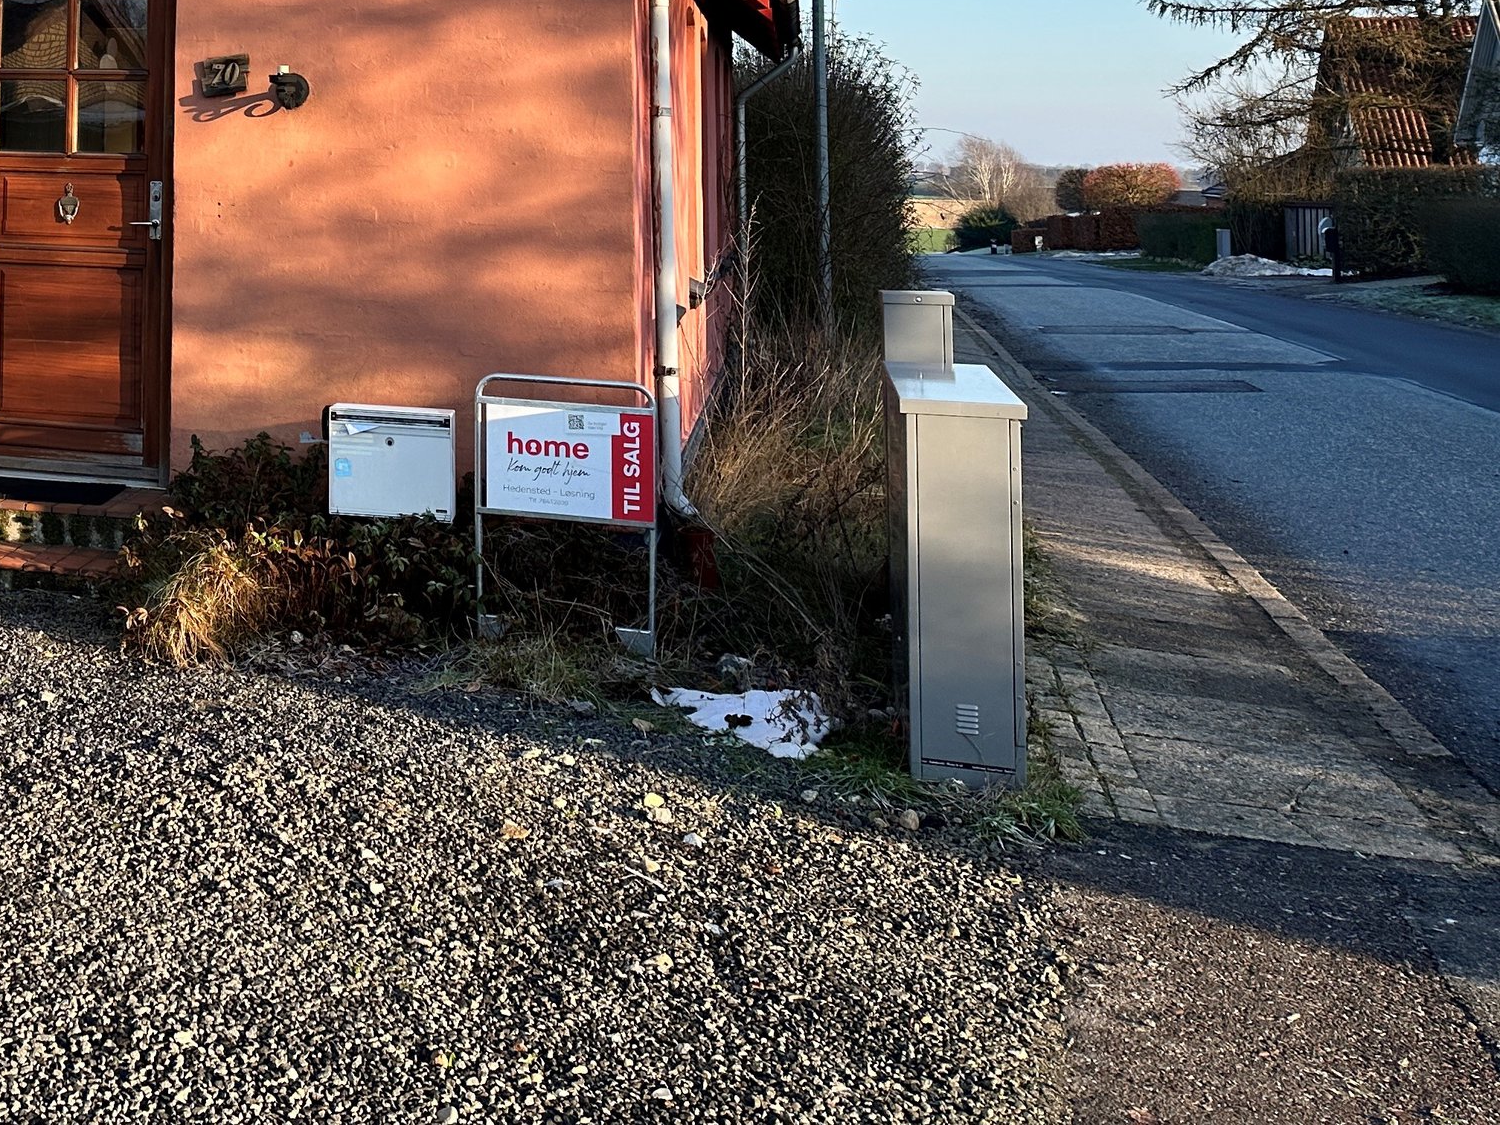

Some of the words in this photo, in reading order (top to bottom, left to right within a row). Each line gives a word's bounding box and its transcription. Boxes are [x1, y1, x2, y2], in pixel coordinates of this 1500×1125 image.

[211, 62, 240, 87] 70
[507, 431, 590, 459] home
[623, 422, 640, 478] SALG
[507, 457, 531, 472] Kom
[532, 460, 561, 481] godt
[562, 461, 591, 485] hjem
[502, 483, 551, 496] Hedensted
[560, 488, 595, 501] Løsning
[623, 482, 640, 514] TIL
